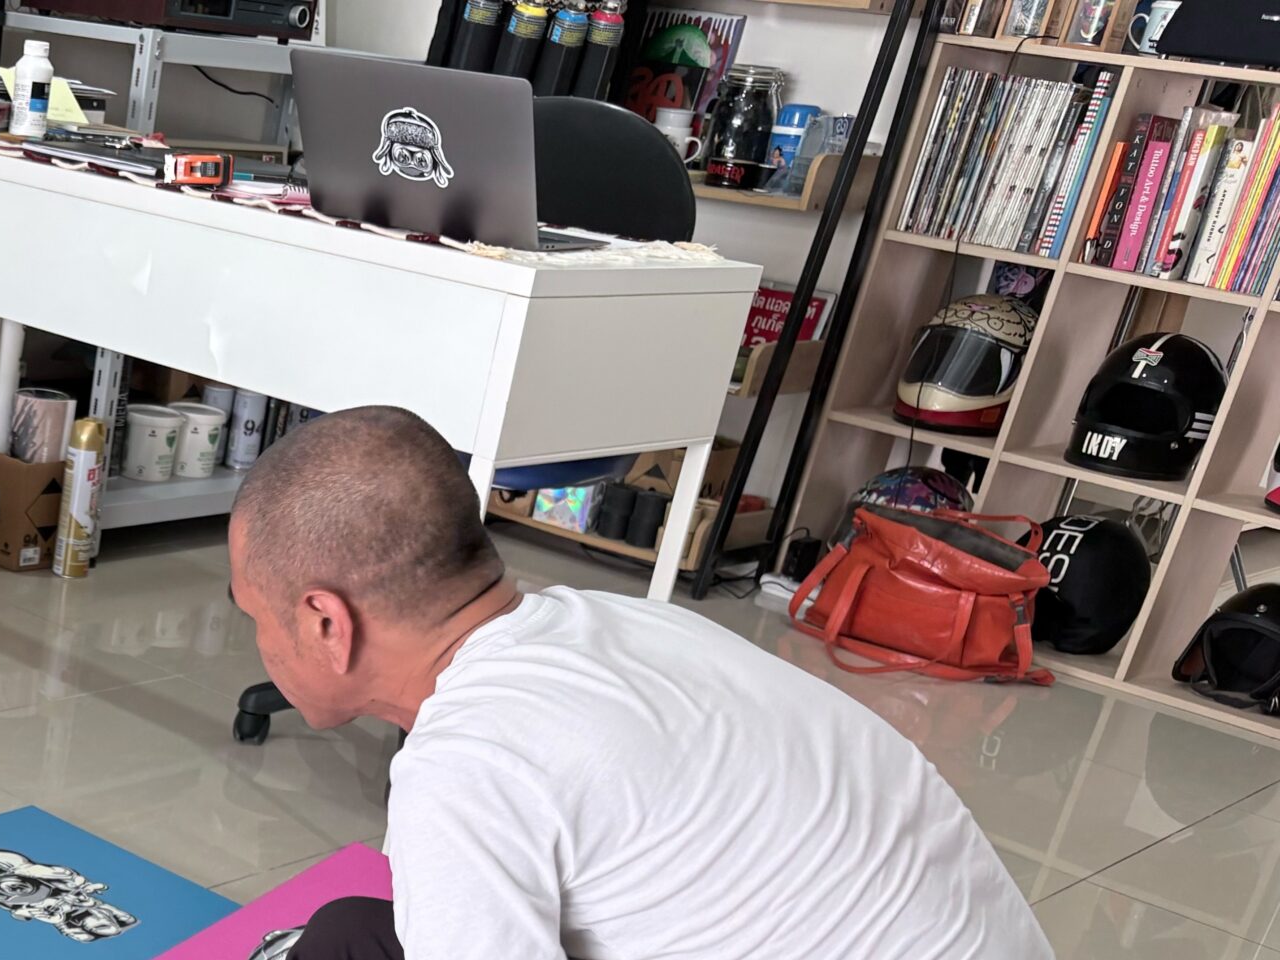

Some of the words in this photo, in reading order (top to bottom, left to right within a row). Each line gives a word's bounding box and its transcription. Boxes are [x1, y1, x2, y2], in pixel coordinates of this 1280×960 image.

[1128, 135, 1143, 171] KAT
[1147, 149, 1163, 178] Tattoo
[1143, 179, 1153, 195] Art
[1111, 187, 1127, 223] VON
[1130, 204, 1147, 236] Design
[1104, 240, 1112, 249] D
[1081, 431, 1127, 461] INDY
[1039, 515, 1099, 592] DES
